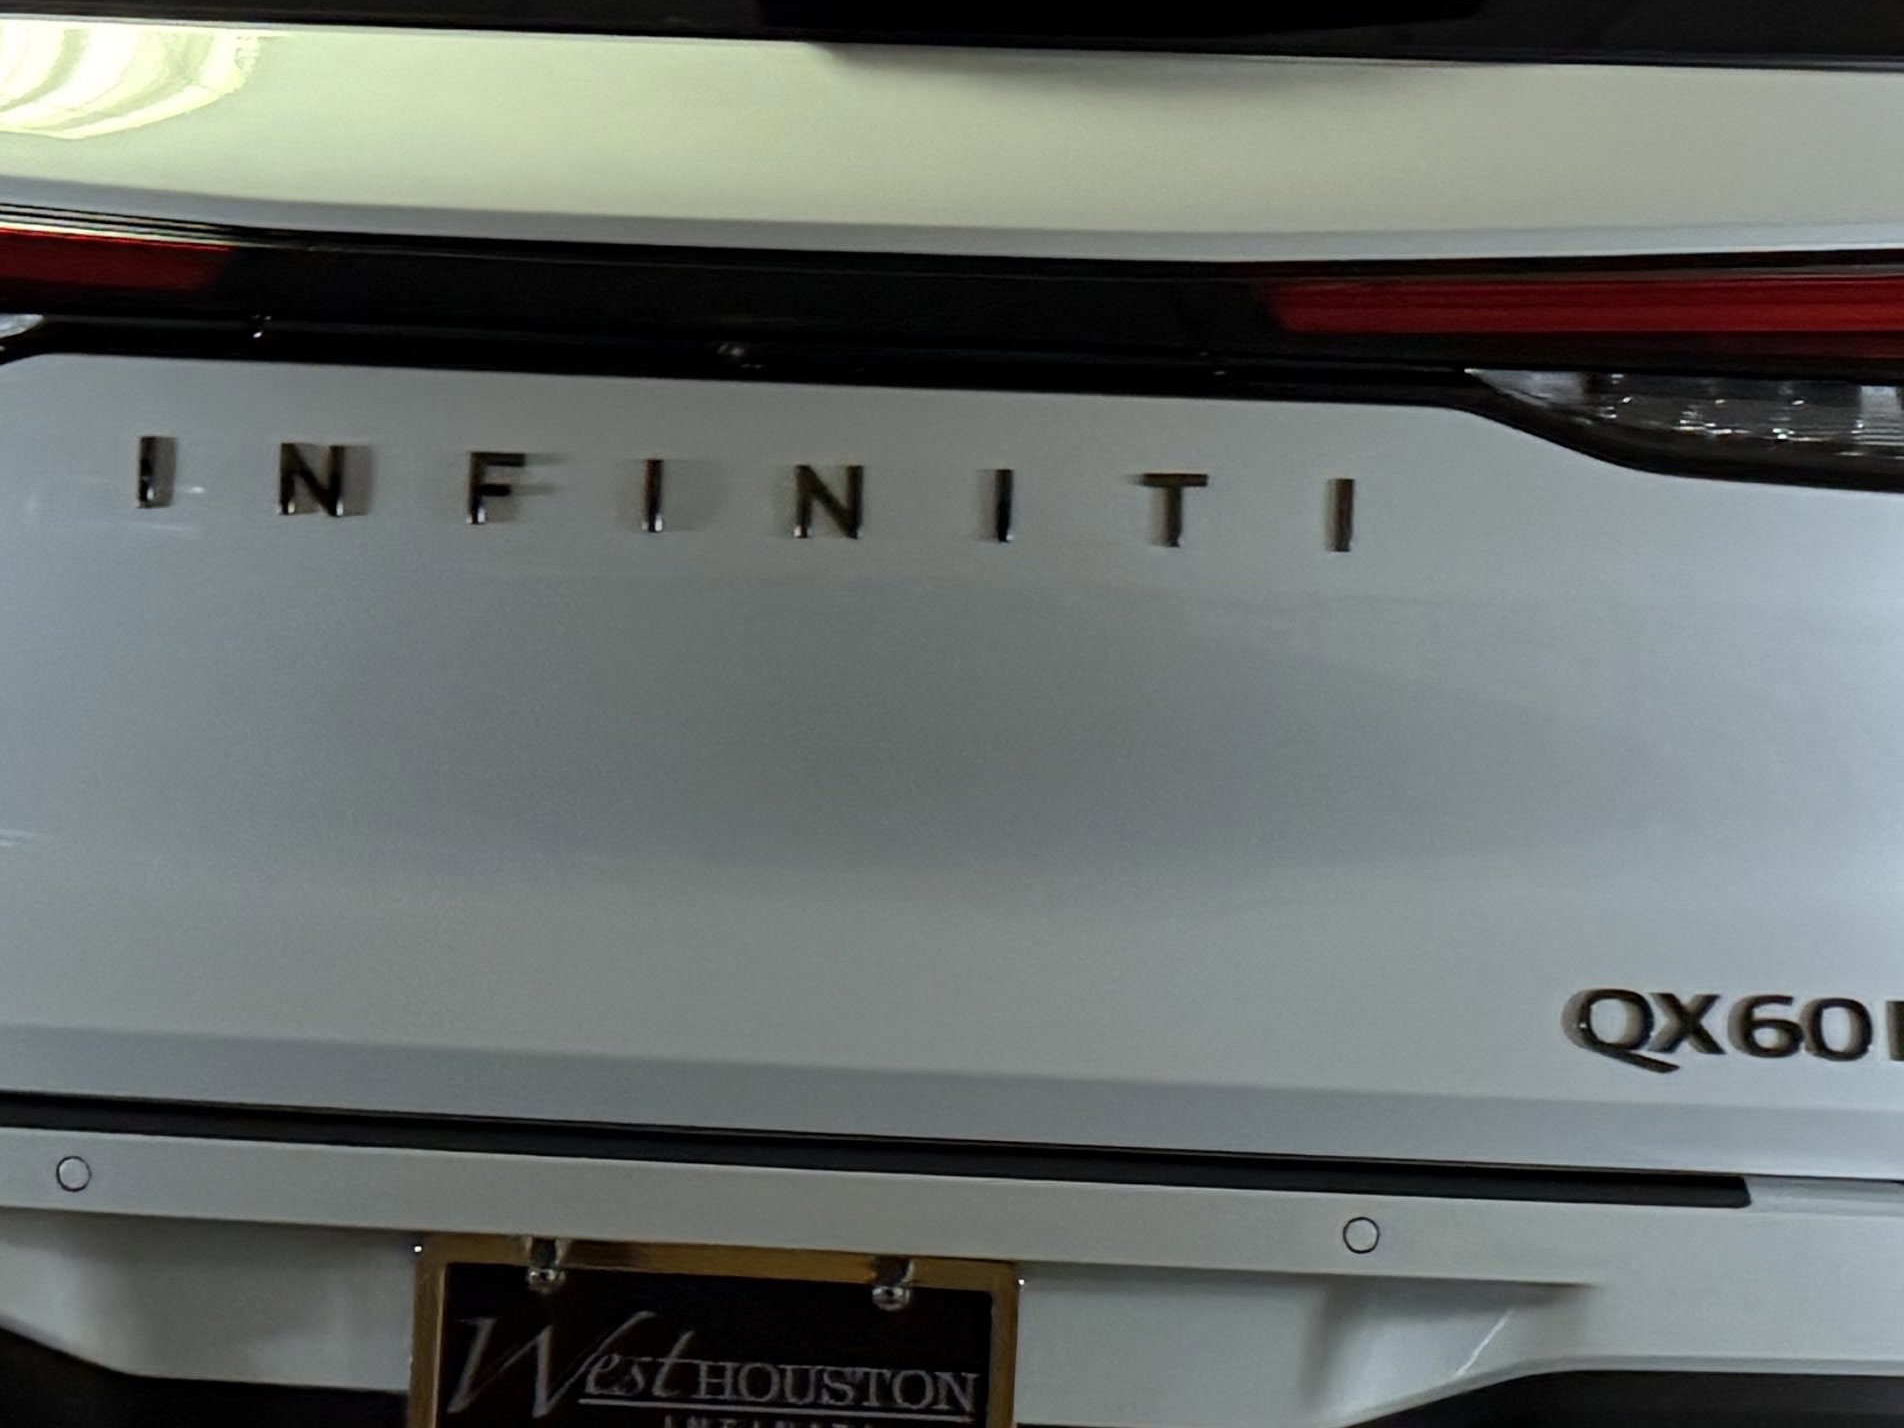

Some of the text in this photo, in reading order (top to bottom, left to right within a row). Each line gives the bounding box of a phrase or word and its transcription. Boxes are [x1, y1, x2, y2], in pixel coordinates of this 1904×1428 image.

[135, 434, 1354, 553] INFINITI
[1561, 988, 1875, 1074] QX60
[446, 1309, 982, 1420] West HOUSTON
